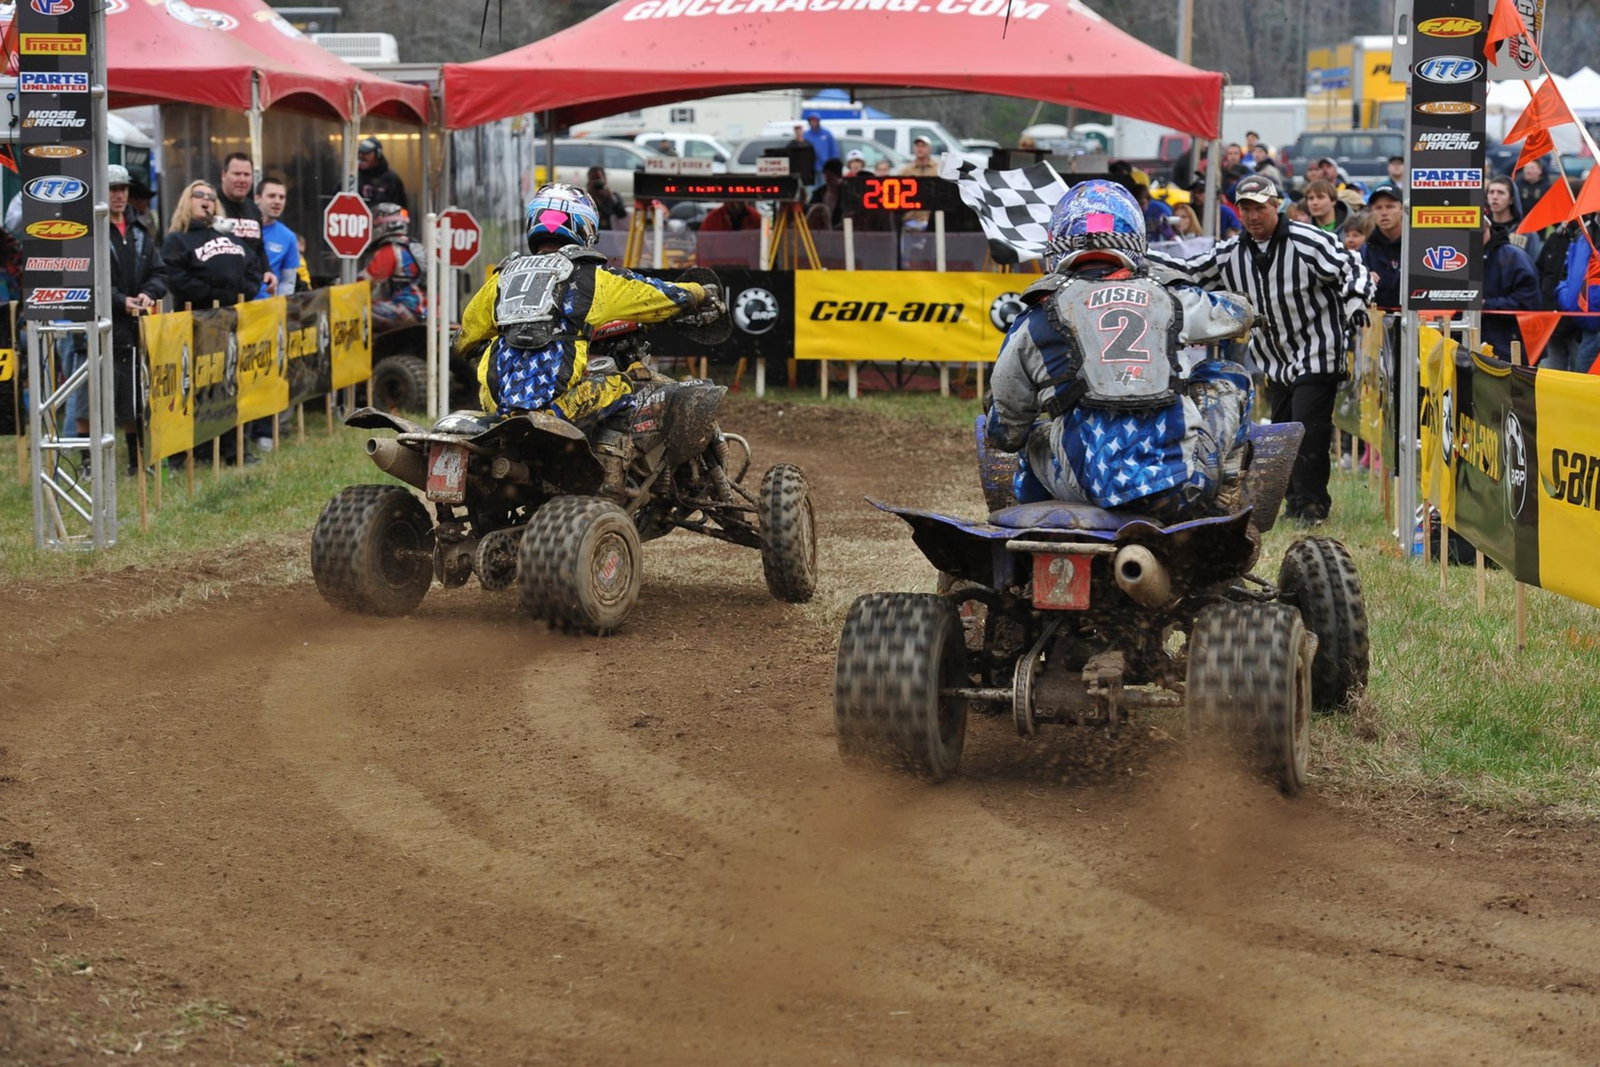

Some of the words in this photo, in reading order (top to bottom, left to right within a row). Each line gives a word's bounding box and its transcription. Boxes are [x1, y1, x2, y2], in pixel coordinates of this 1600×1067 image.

[1418, 20, 1482, 32] FMF
[25, 37, 83, 51] PIRELLI
[1422, 61, 1475, 78] ITP
[22, 73, 87, 84] PARTS
[27, 110, 77, 119] MOOSE
[34, 119, 87, 127] RACING
[1419, 133, 1471, 141] MOOSE
[1425, 141, 1480, 150] RACING
[1413, 170, 1480, 180] PARTS
[31, 180, 81, 198] ITP
[1417, 210, 1477, 223] PIRELLI
[26, 223, 89, 235] FMF
[328, 213, 369, 238] STOP
[1426, 246, 1457, 270] VP
[28, 288, 90, 303] AMSOIL
[504, 271, 555, 307] 4
[1090, 286, 1148, 307] KISER
[751, 311, 777, 320] BRP
[810, 300, 964, 323] can-am
[1100, 308, 1150, 362] 2
[432, 446, 462, 487] 4
[1048, 558, 1075, 603] 2
